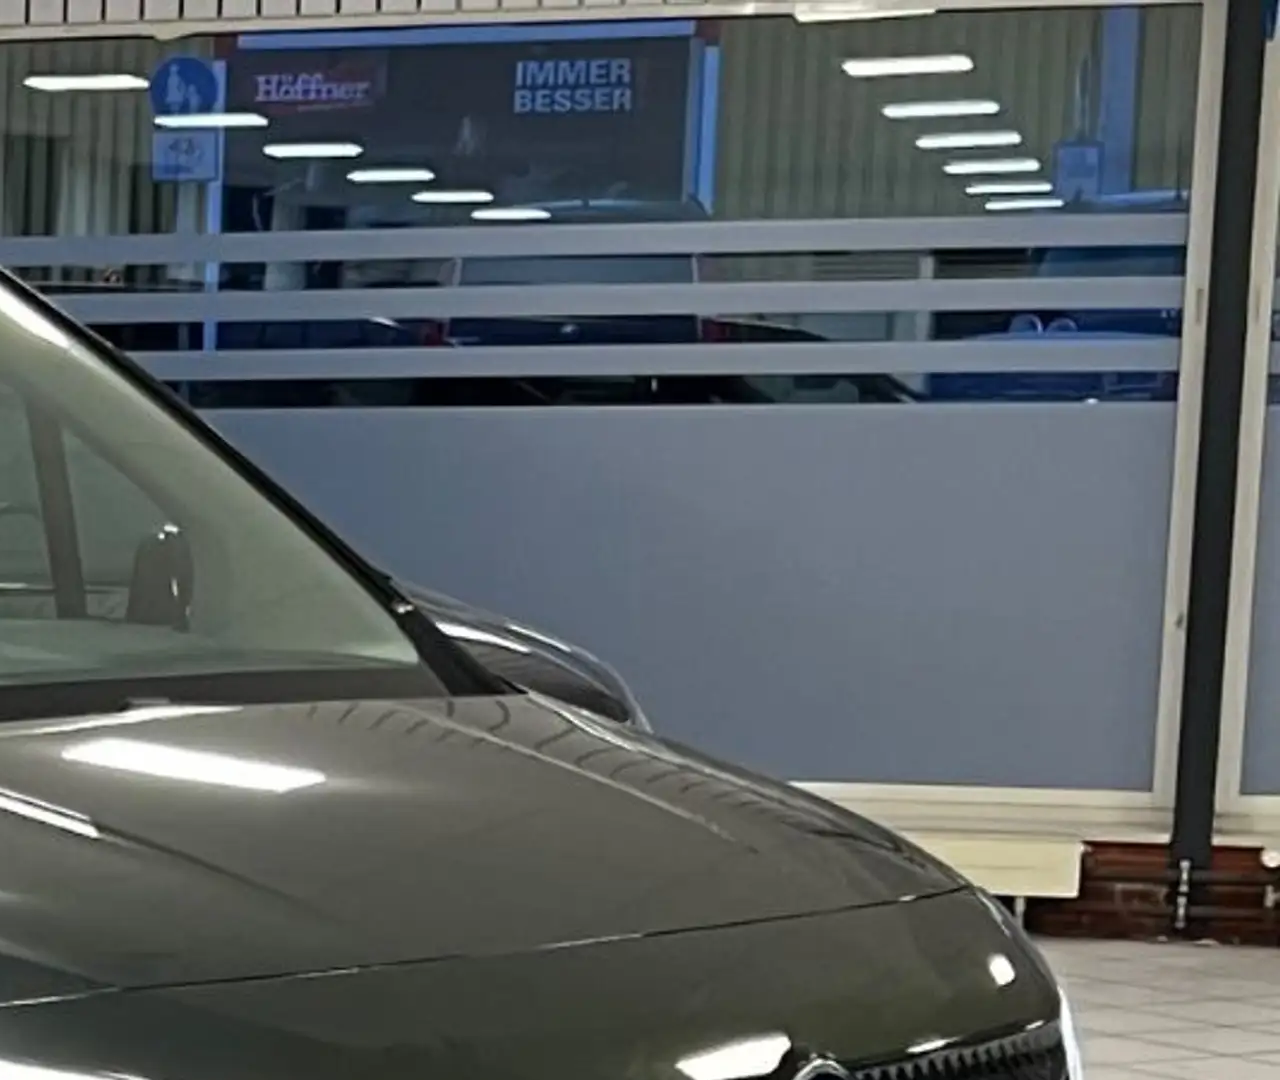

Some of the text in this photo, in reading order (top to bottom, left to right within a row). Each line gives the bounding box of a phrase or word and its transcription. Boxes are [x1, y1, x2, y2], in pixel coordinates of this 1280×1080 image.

[515, 58, 632, 87] IMMER
[254, 72, 371, 103] Höffner
[513, 87, 633, 114] BESSER
